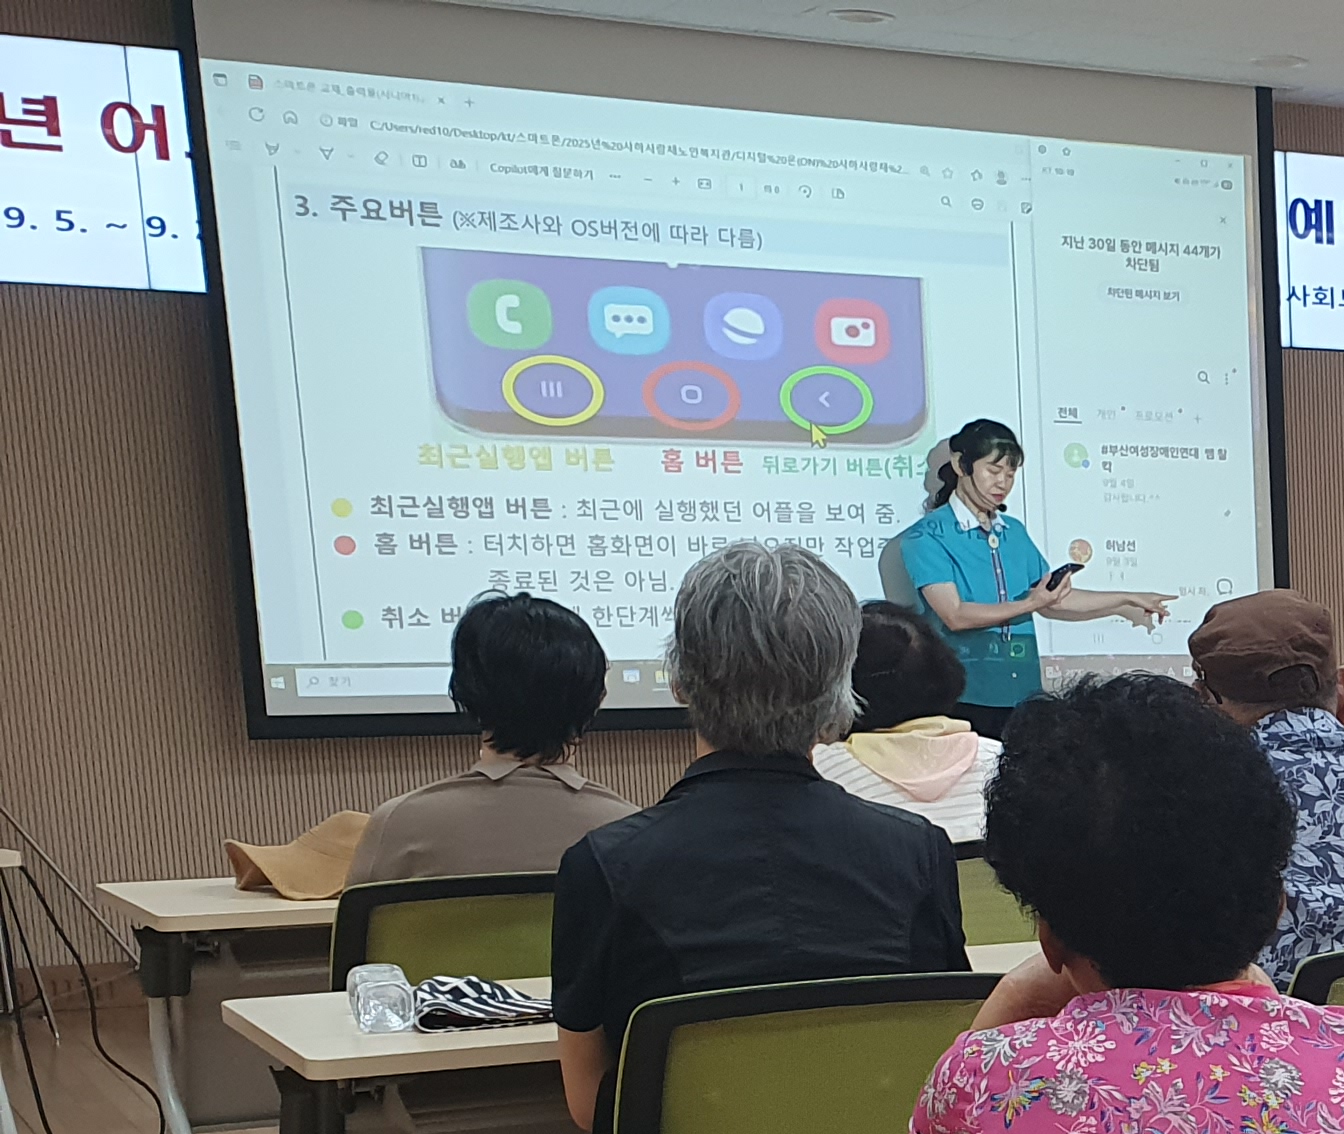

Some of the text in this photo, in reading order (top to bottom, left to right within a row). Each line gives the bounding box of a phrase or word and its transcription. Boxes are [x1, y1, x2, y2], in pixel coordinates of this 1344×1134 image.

[100, 100, 193, 162] 어
[294, 194, 763, 251] 3. 주요버튼 (※제조사와 OS버전에 따라 다름)
[1061, 235, 1221, 260] 지난 30일 동안 메시지 44개가
[1125, 256, 1160, 272] 차단됨
[1057, 407, 1078, 419] 전체
[418, 443, 615, 472] 최근실행앱 버튼
[661, 449, 743, 474] 홈 버튼
[762, 455, 838, 476] 뒤로가기
[370, 494, 495, 519] 최근실행앱
[505, 496, 553, 519] 버튼
[576, 498, 643, 521] 최근에
[654, 499, 742, 523] 실행했던
[752, 501, 816, 523] 어플을
[825, 503, 865, 524] 보여
[874, 503, 900, 524] 줌.
[374, 532, 398, 556] 홈
[409, 532, 458, 556] 버튼
[483, 533, 576, 556] 터치하면
[587, 534, 677, 557] 홈화면이
[488, 569, 675, 592] 종료된 것은 아님.
[381, 606, 431, 629] 취소
